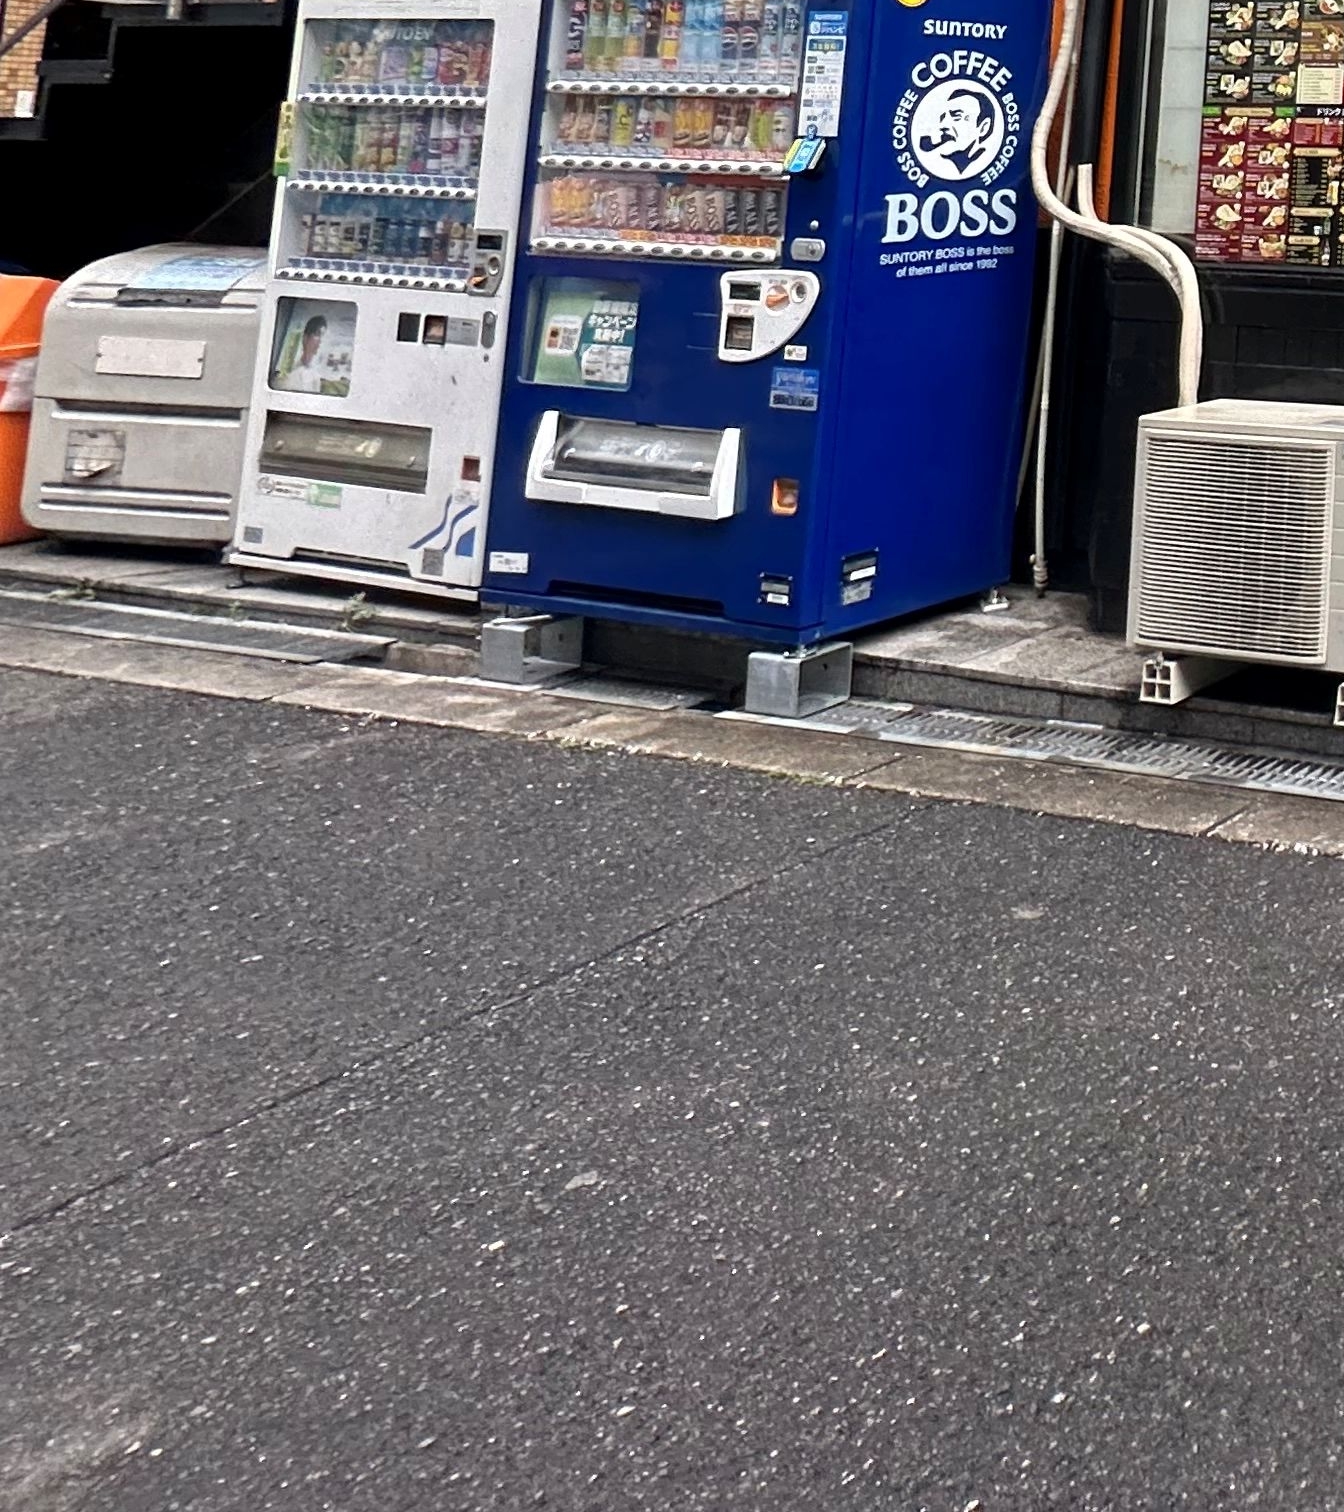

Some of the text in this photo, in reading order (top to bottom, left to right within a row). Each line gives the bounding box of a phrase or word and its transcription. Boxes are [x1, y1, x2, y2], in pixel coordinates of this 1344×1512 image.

[923, 19, 1008, 39] SUNTORY
[911, 50, 1012, 92] COFFEE
[892, 89, 930, 188] BOSS COFFEE
[980, 92, 1020, 186] BOSS COFFEE
[881, 188, 1017, 244] BOSS
[879, 245, 1015, 266] SUNTORY BOSS is the boss
[896, 267, 906, 278] of
[908, 265, 933, 277] them
[935, 262, 947, 274] all
[949, 261, 973, 273] since
